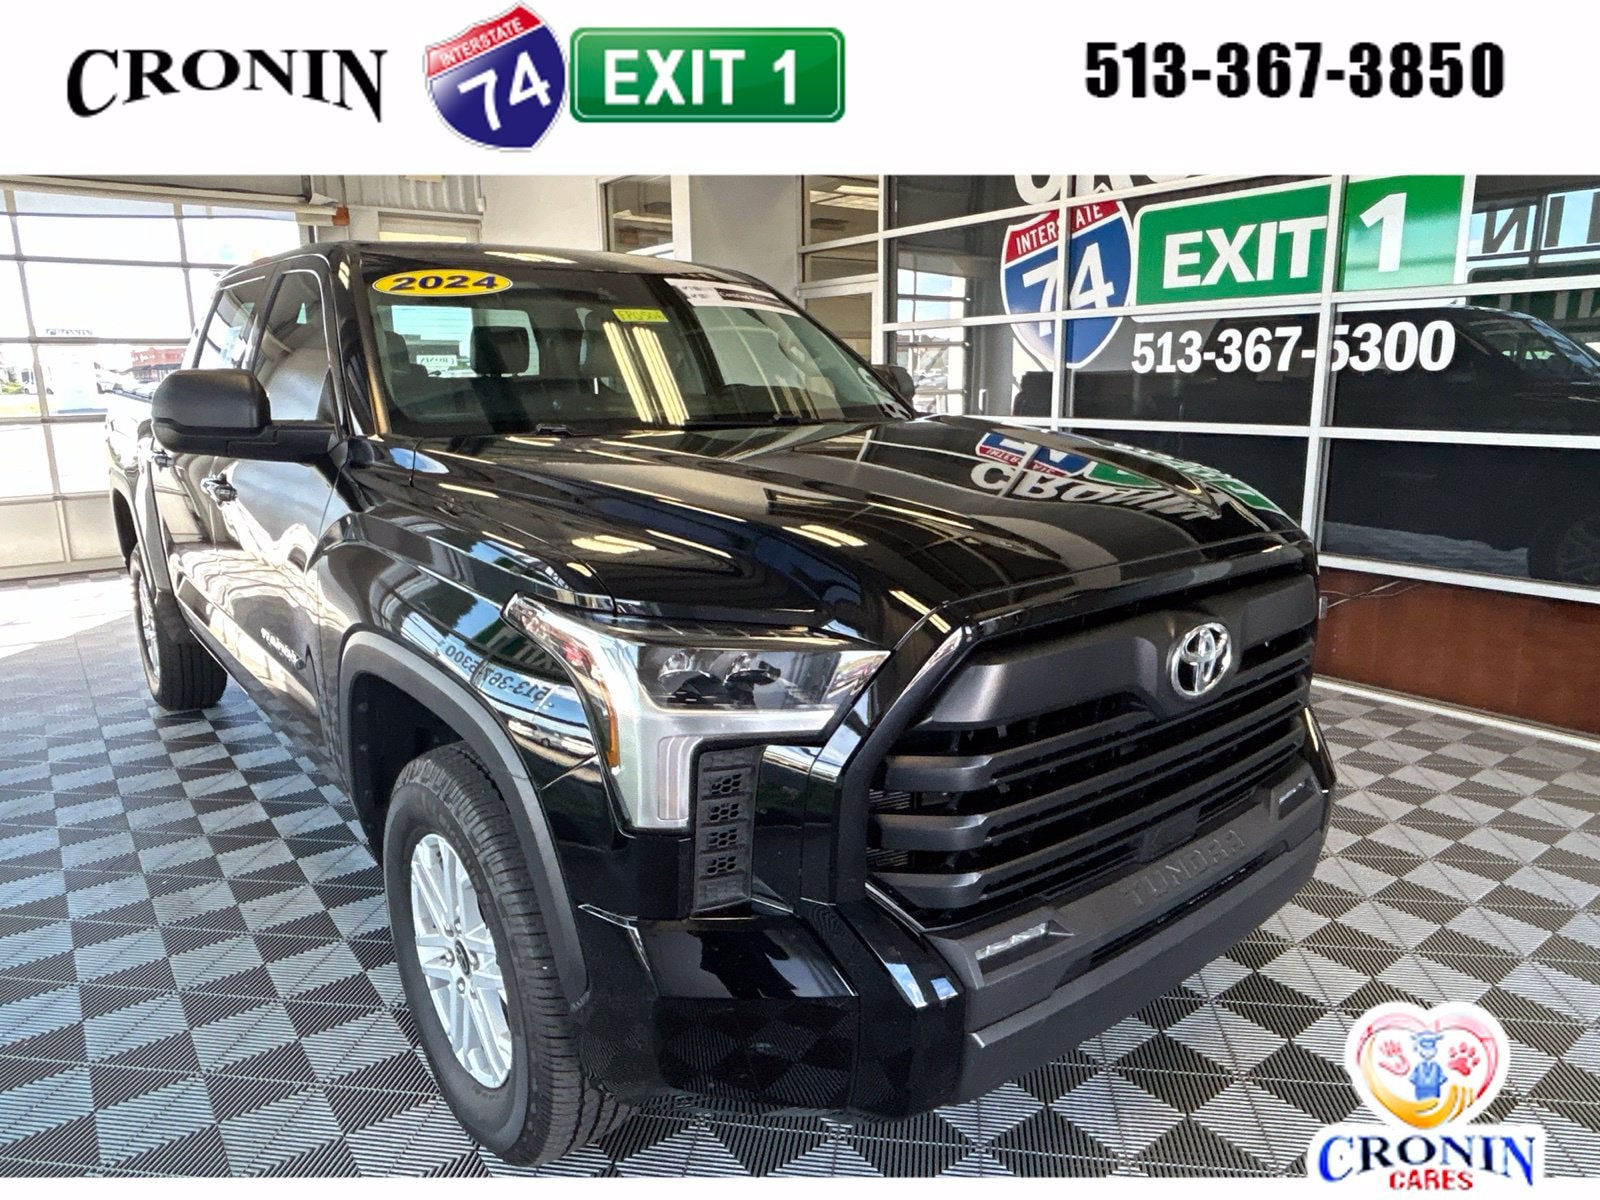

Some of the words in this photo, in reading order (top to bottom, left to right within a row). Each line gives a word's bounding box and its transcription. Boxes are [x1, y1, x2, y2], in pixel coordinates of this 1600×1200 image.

[1016, 205, 1103, 255] INTERATE
[1162, 215, 1327, 289] EXIT
[1359, 192, 1407, 273] 1
[389, 275, 498, 292] 2024
[1022, 242, 1115, 337] 74
[1131, 319, 1456, 374] 513-367-5300
[1119, 829, 1246, 908] TUNDRA
